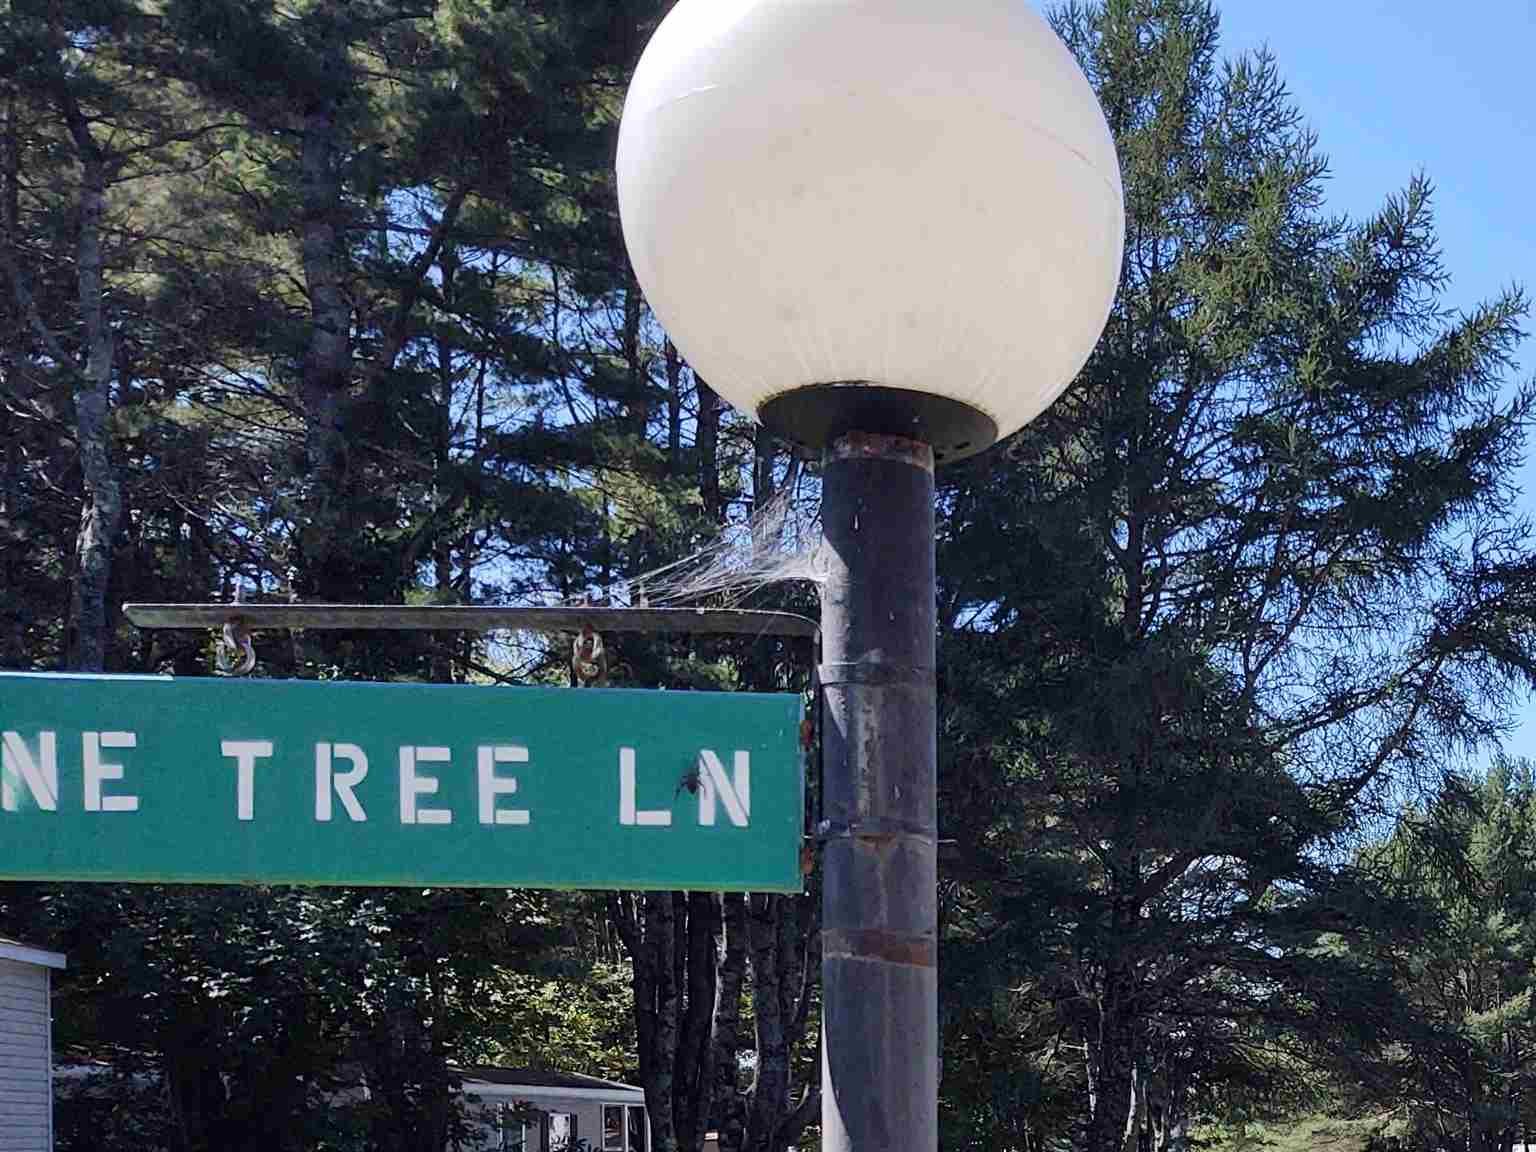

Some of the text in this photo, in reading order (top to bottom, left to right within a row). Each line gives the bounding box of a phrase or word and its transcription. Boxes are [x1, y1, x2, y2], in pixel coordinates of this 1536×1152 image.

[1, 731, 750, 827] NE TREE LN
